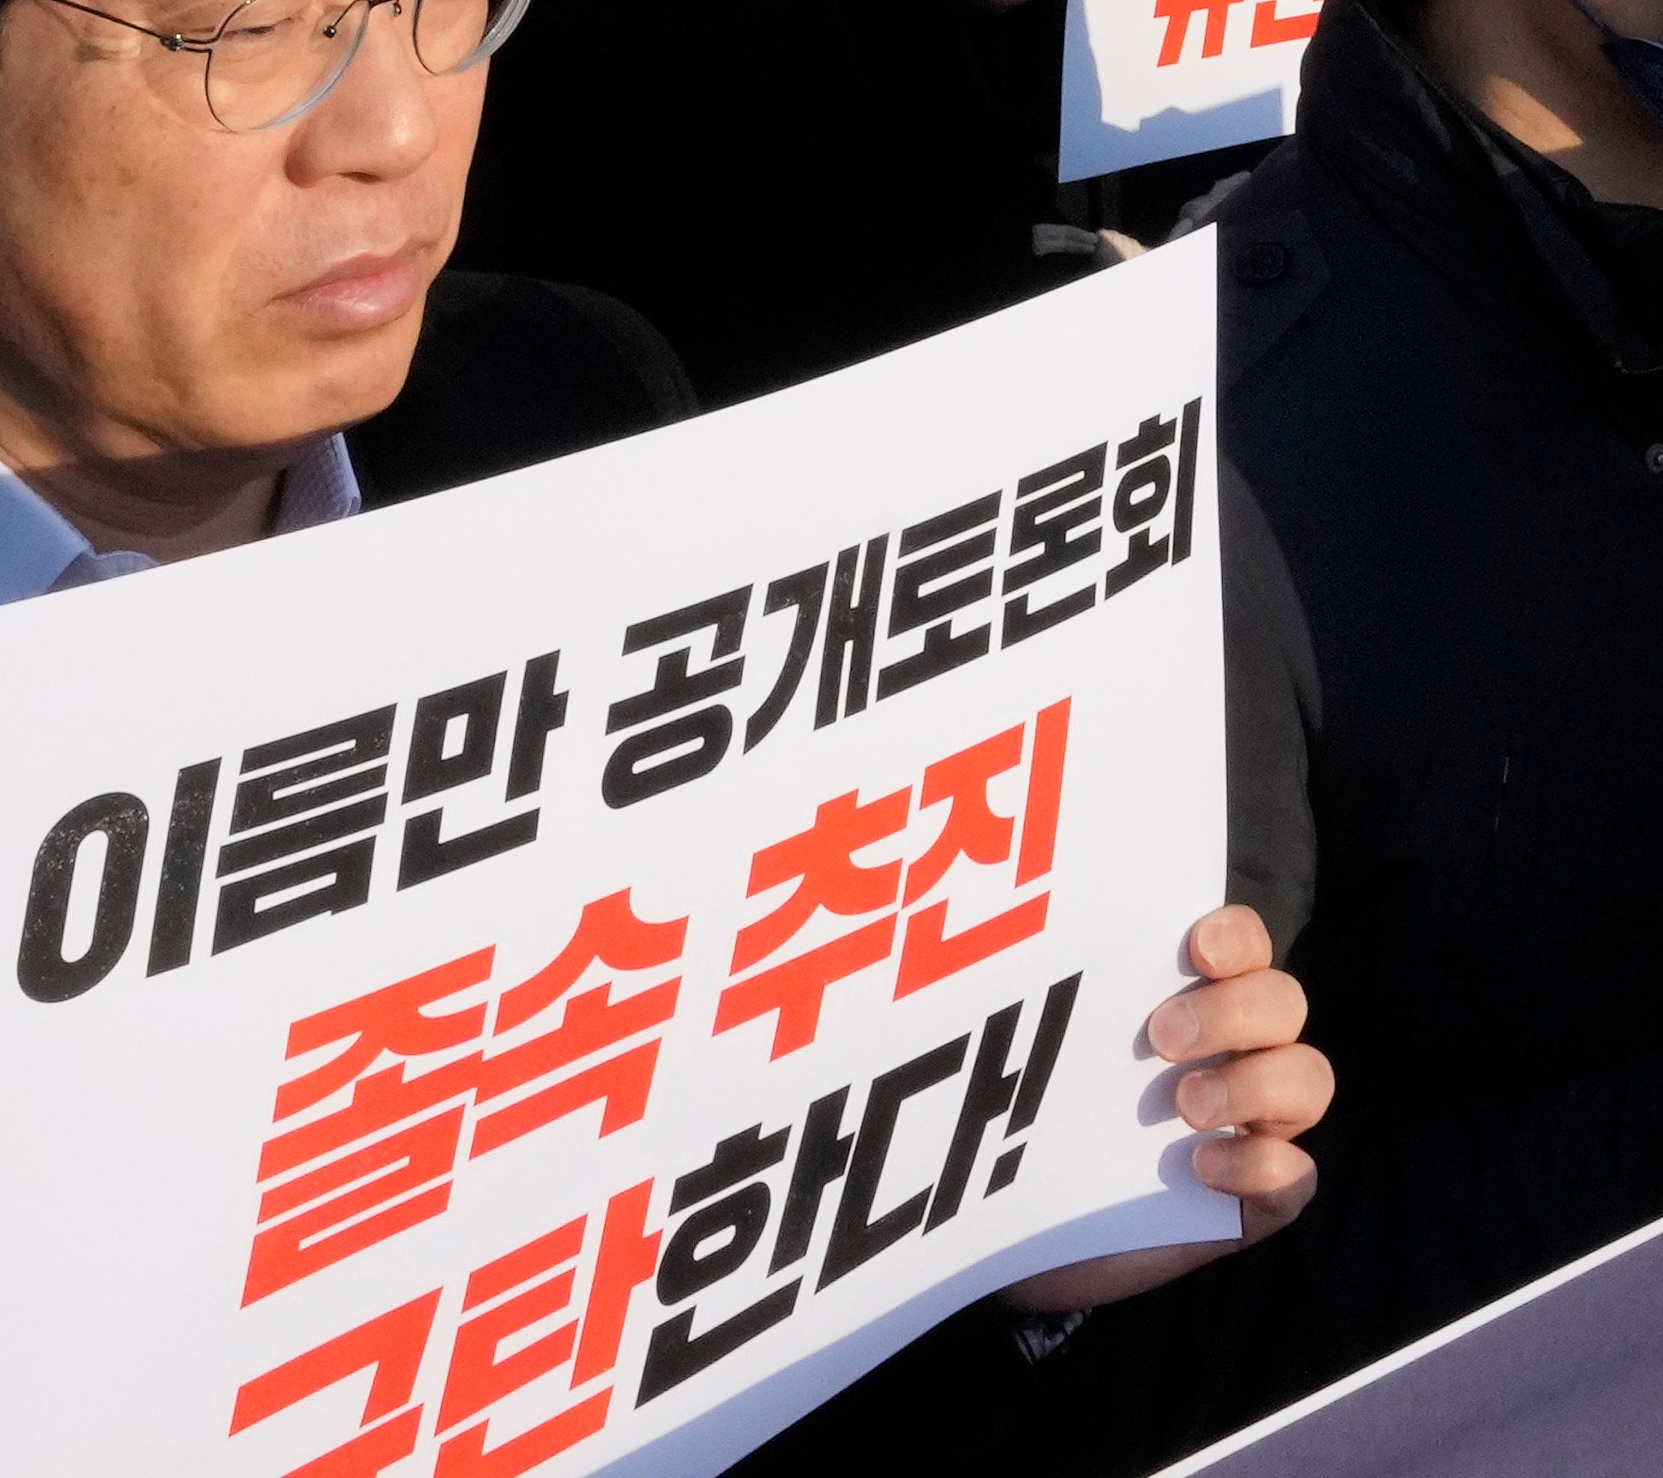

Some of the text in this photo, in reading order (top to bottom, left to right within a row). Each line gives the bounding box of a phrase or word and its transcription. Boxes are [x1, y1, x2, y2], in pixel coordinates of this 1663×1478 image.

[17, 396, 1203, 1006] 이름만 공개토론회
[239, 695, 1074, 1311] 졸속 추진
